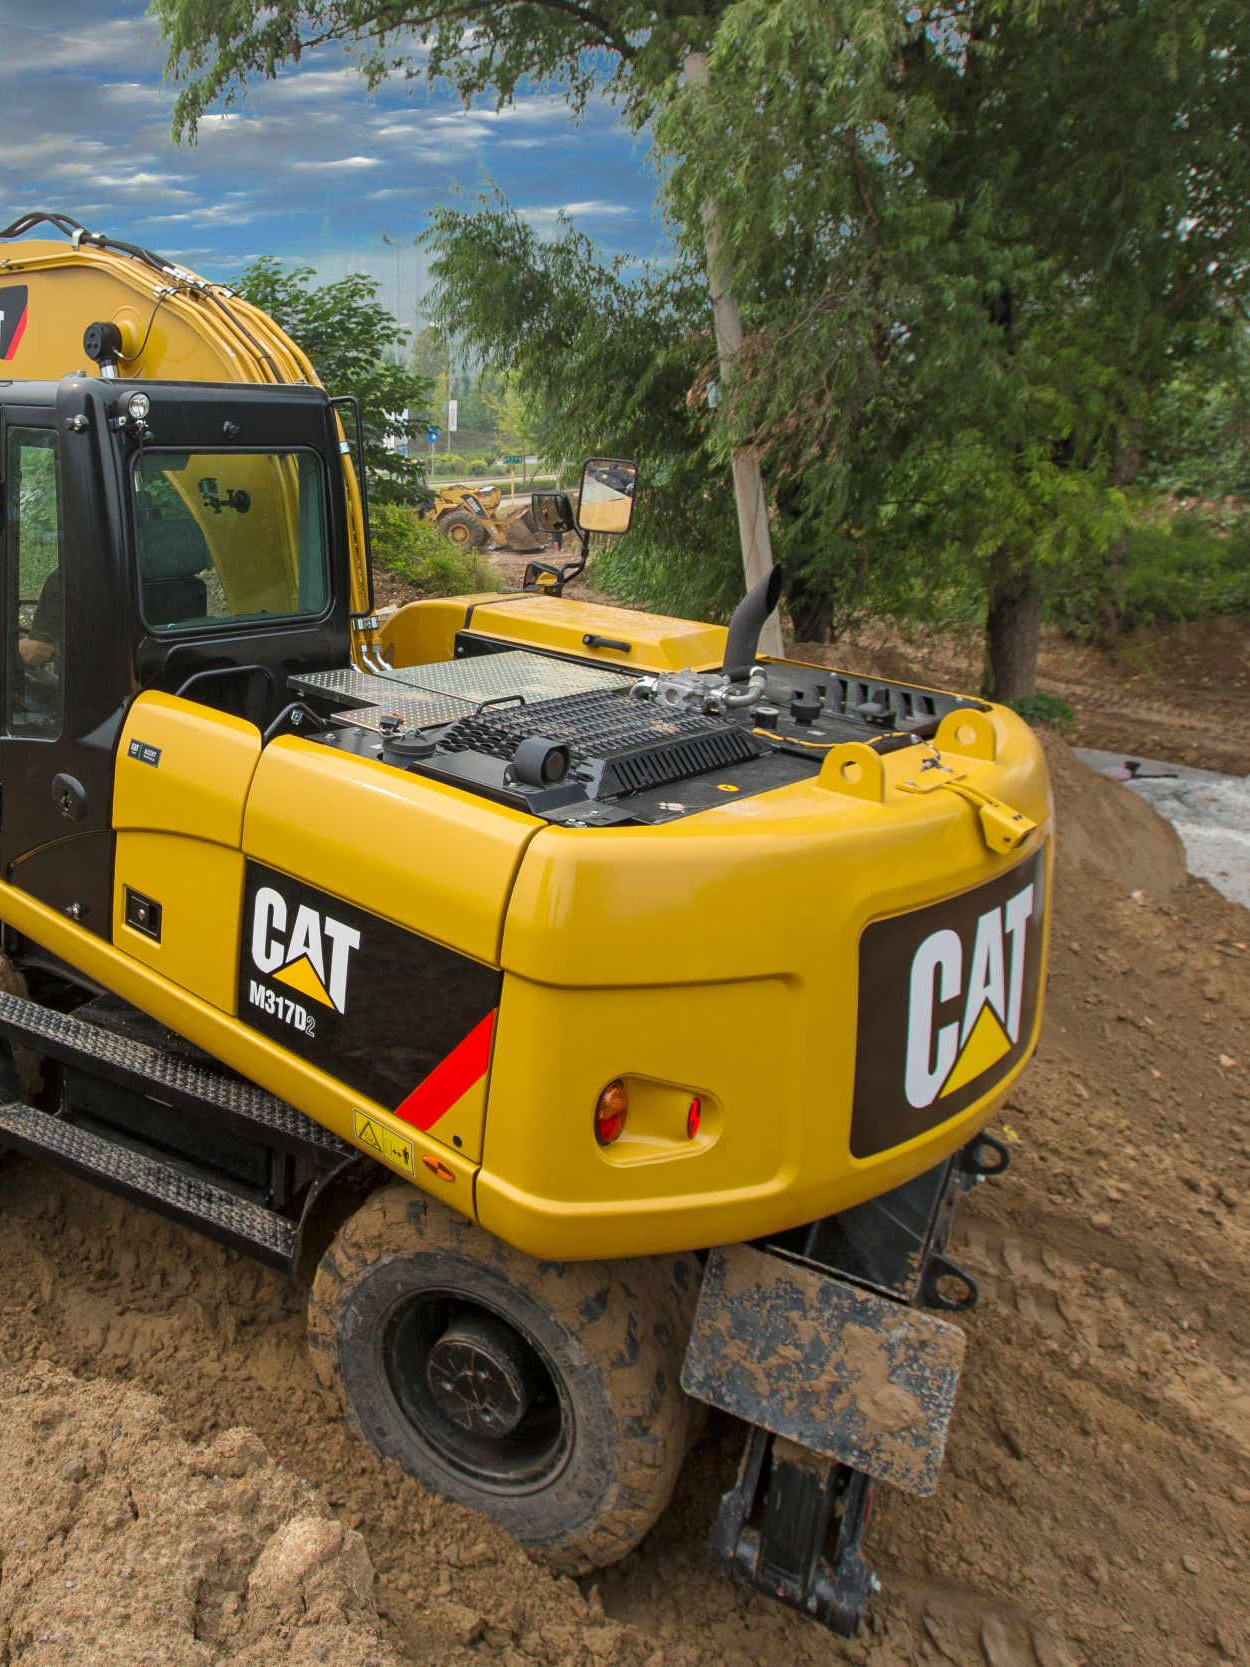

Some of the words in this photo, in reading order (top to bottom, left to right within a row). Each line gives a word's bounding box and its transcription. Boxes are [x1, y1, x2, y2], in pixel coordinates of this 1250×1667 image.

[250, 979, 316, 1038] M317D2
[252, 887, 361, 1015] CAT
[904, 883, 1035, 1109] CAT
